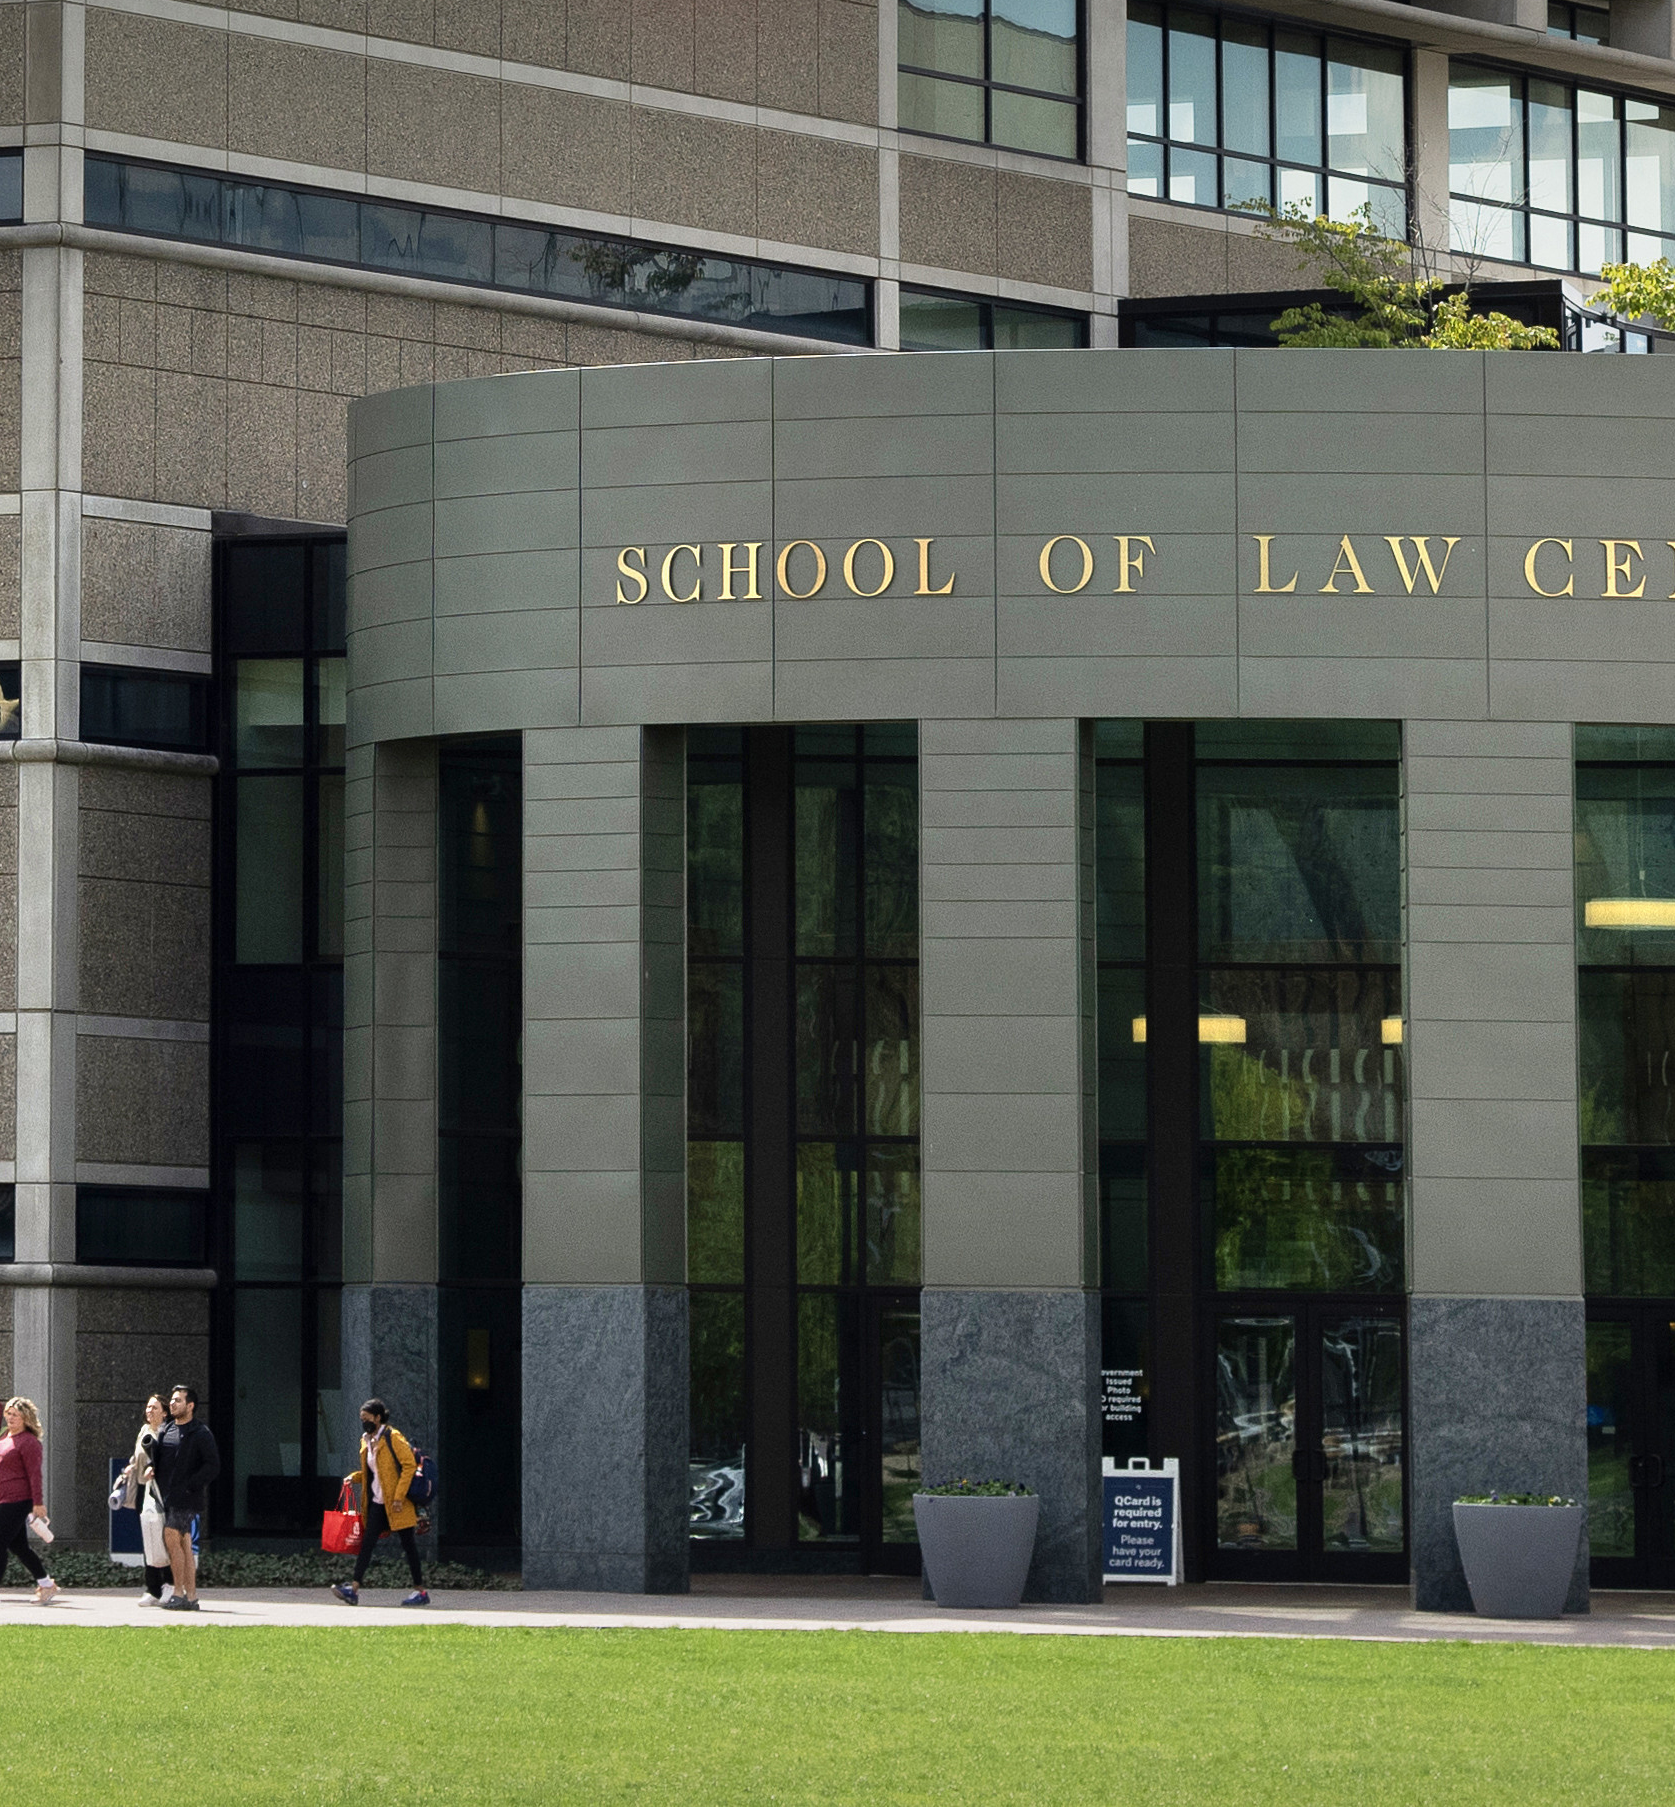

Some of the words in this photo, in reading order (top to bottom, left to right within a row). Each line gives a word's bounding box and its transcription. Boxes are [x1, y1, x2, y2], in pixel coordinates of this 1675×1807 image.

[615, 538, 958, 604] SCHOOL
[1039, 534, 1157, 594] OF
[1253, 533, 1462, 594] LAW
[1107, 1386, 1131, 1394] Photo
[1101, 1395, 1107, 1403] D
[1110, 1404, 1142, 1413] building
[1115, 1496, 1150, 1507] QCard
[1152, 1496, 1162, 1506] is
[1114, 1507, 1162, 1518] required
[1112, 1518, 1129, 1528] for
[1130, 1520, 1163, 1530] entry.
[1121, 1535, 1154, 1545] Please
[1112, 1545, 1137, 1556] have
[1138, 1548, 1162, 1558] your
[1109, 1557, 1132, 1567] card
[1134, 1557, 1165, 1570] ready.
